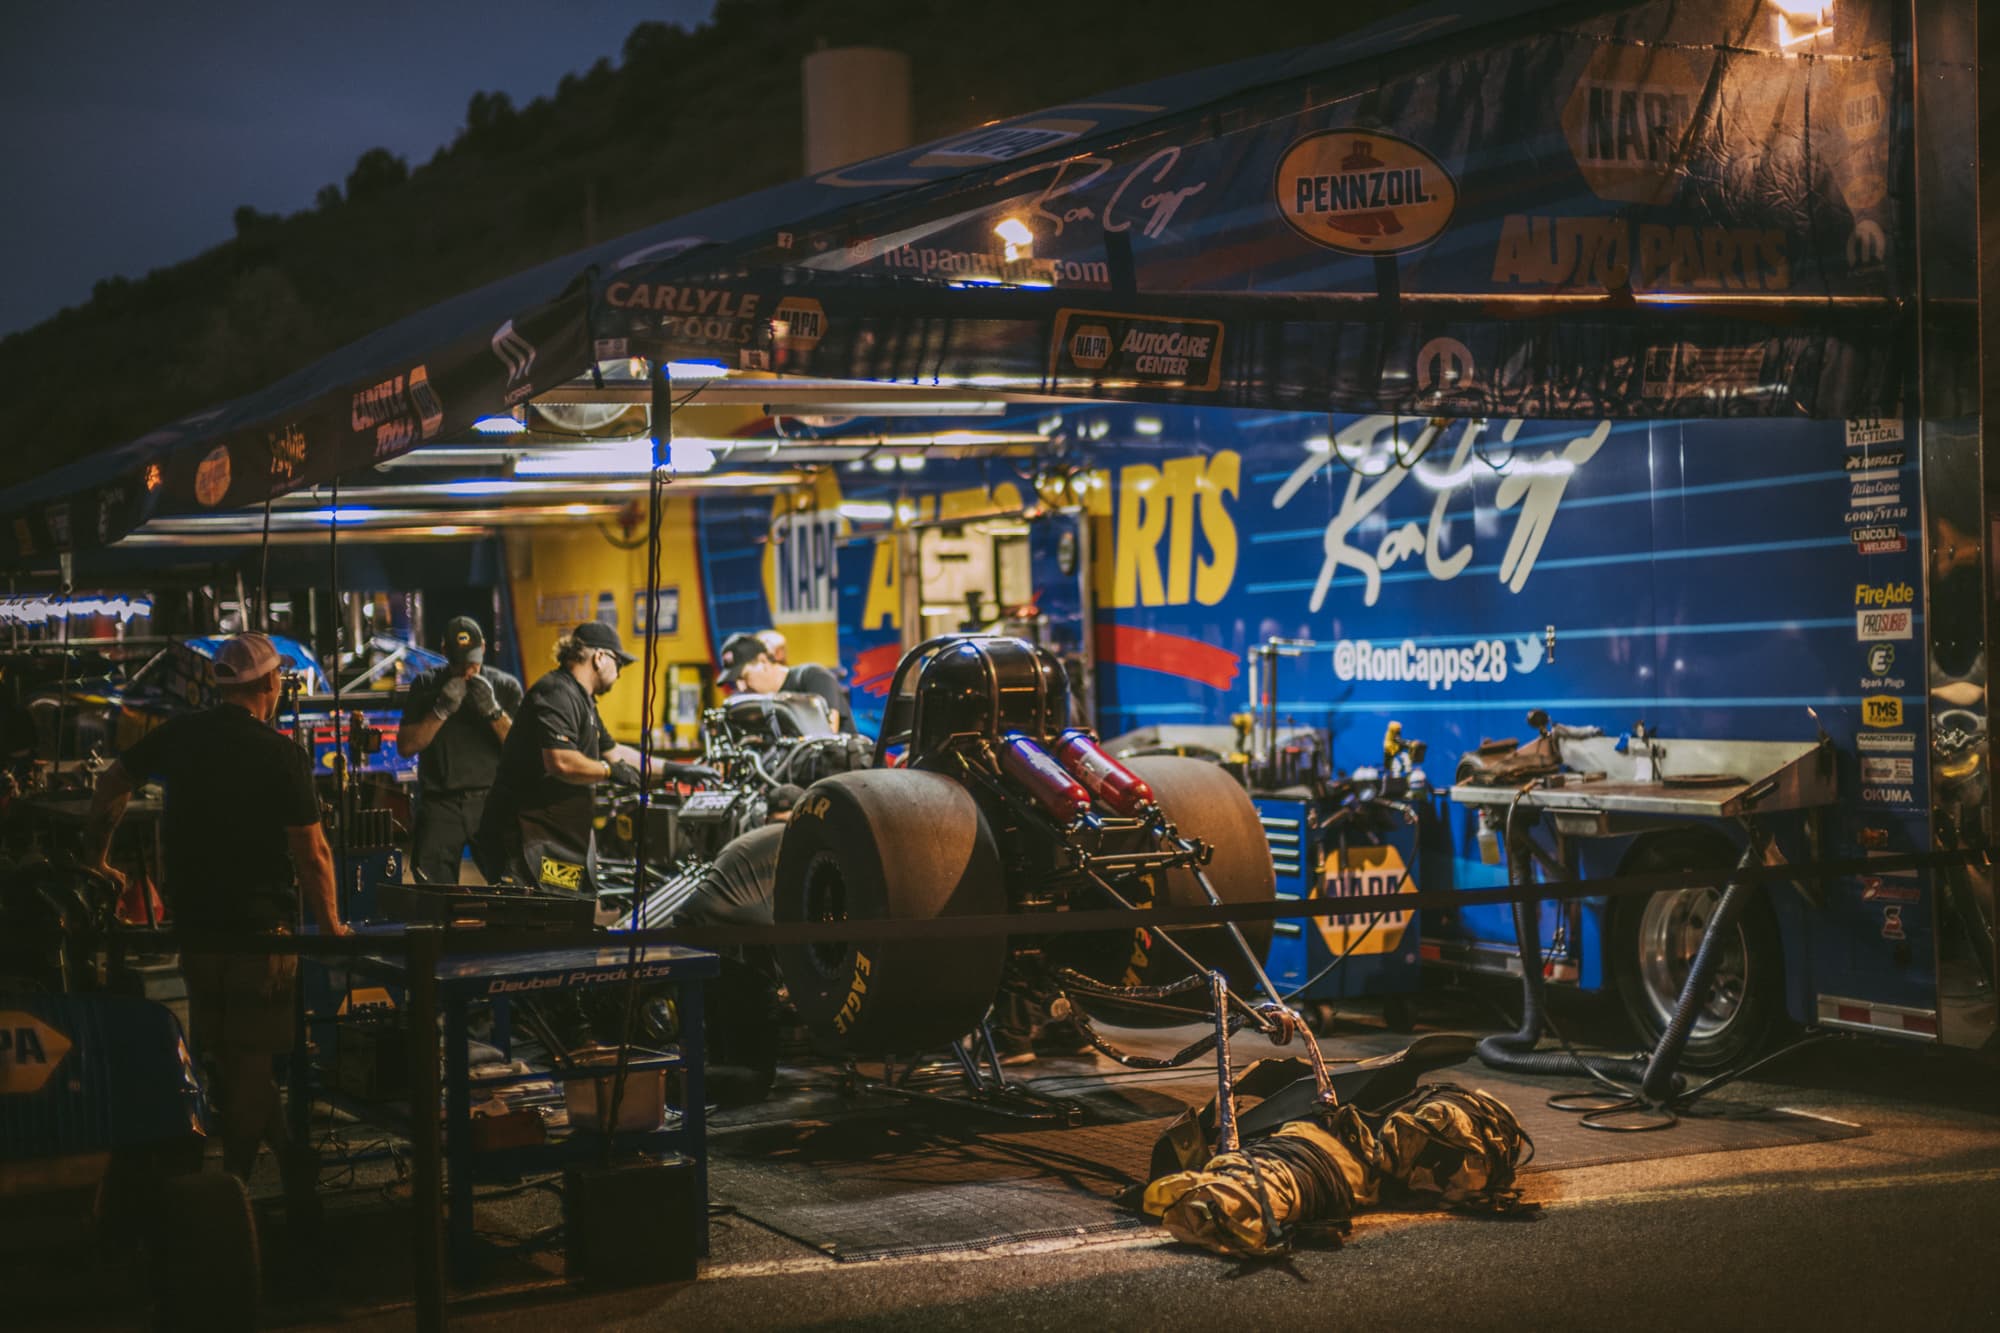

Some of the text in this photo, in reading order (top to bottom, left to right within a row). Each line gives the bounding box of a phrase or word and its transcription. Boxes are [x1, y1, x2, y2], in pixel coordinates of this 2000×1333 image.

[1296, 169, 1429, 214] PENNZOIL
[1493, 214, 1791, 290] AUTO PARTS
[604, 281, 762, 318] CARLYLE
[662, 315, 753, 344] TOOLS
[1074, 335, 1108, 359] NAPA
[1135, 354, 1189, 376] CENTER
[1850, 428, 1900, 443] TACTICAL
[1844, 506, 1908, 523] GOODYEAR
[1853, 528, 1897, 541] LINCOLN
[1855, 582, 1914, 608] FireAde
[1333, 640, 1507, 690] @RonCapps28
[1868, 701, 1899, 717] TMS
[1863, 788, 1913, 803] OKUMA
[487, 974, 562, 993] Deubel
[832, 951, 871, 1035] EAGLE
